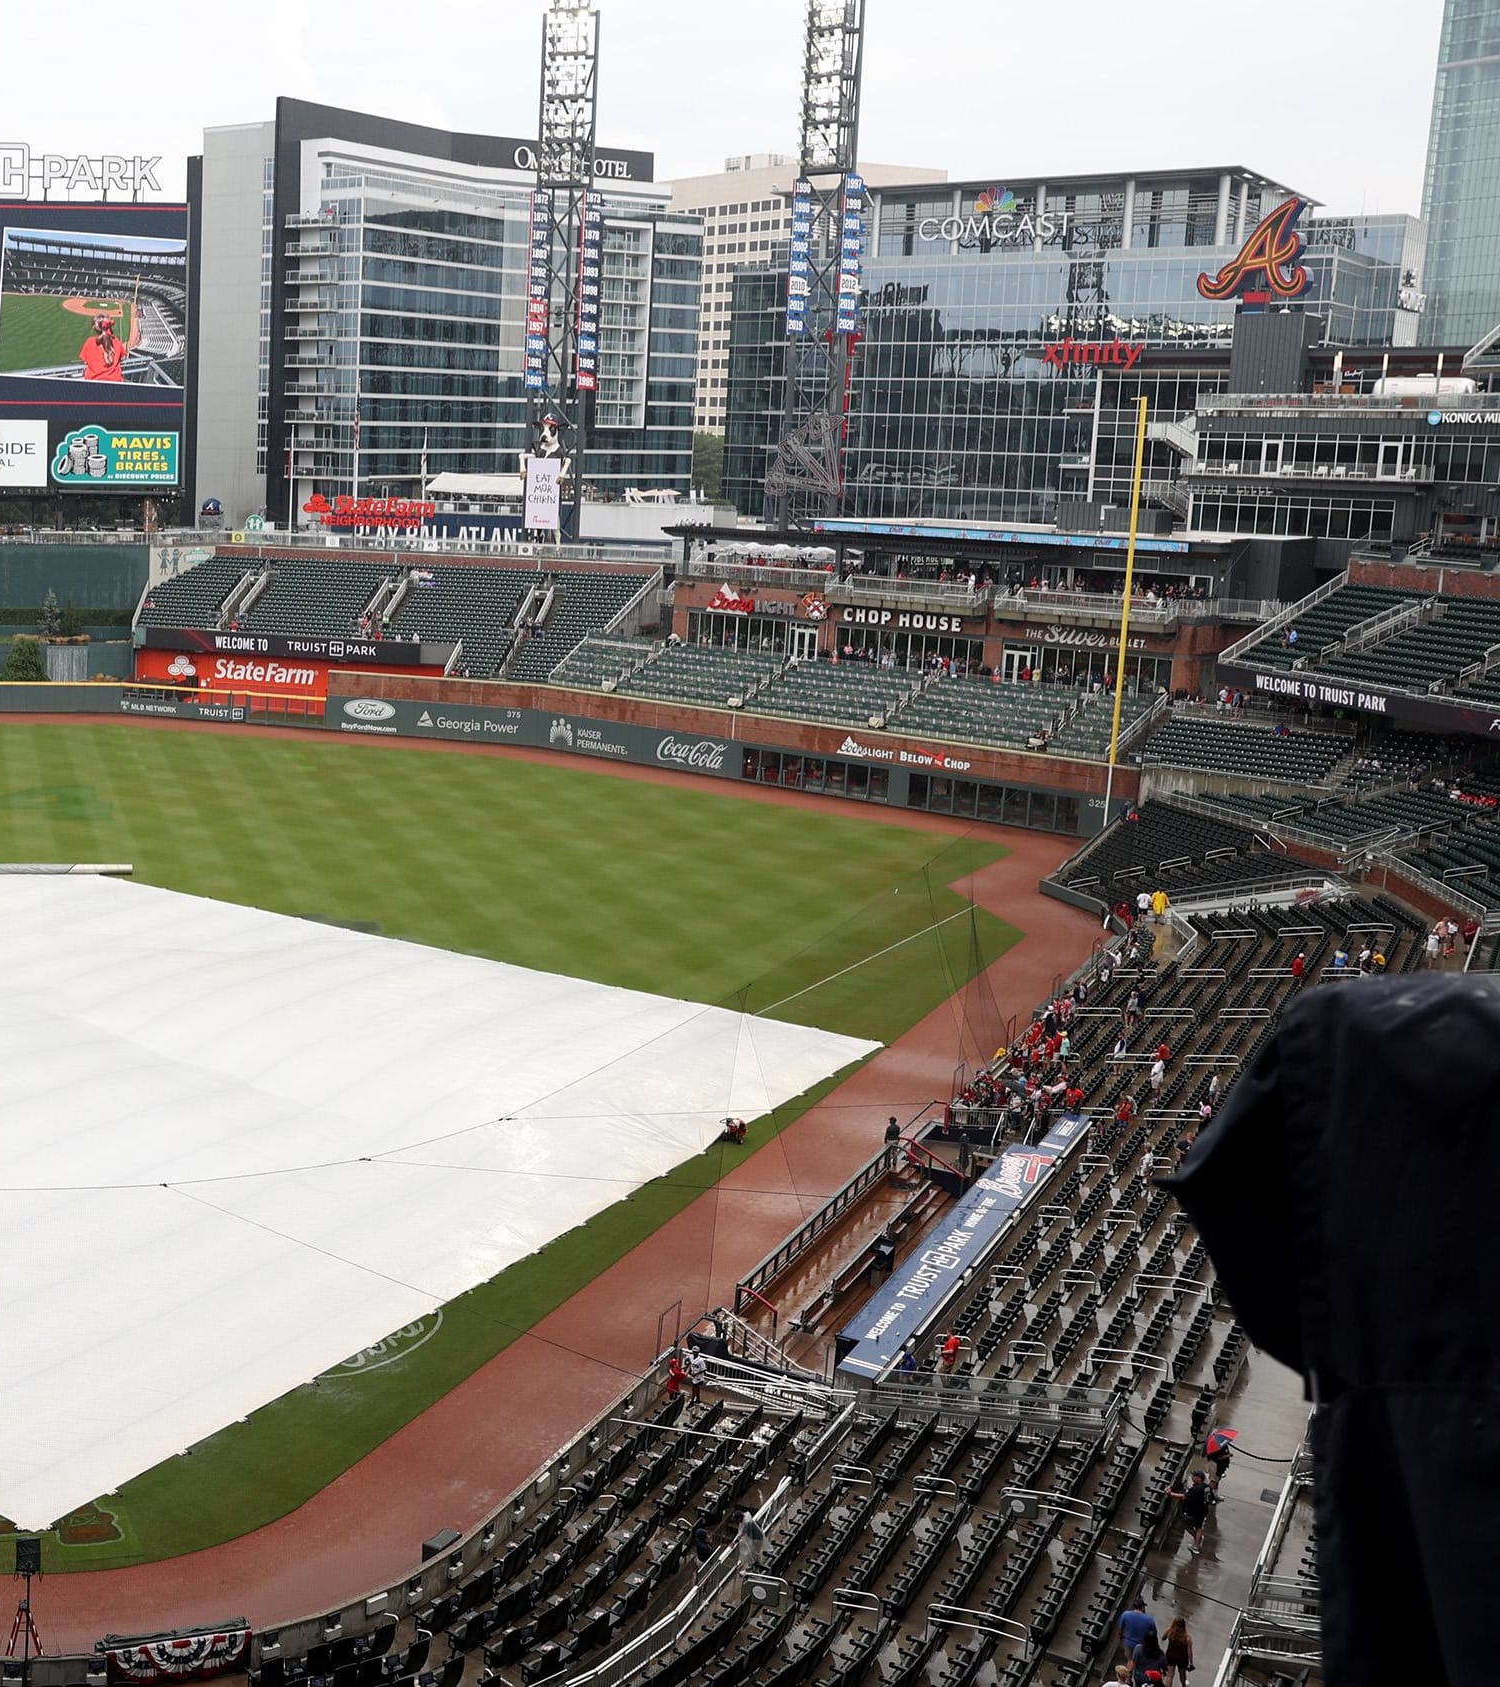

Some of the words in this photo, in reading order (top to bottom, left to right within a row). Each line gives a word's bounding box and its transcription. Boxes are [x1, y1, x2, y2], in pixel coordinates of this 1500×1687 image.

[43, 154, 162, 191] PARK
[847, 178, 862, 188] 1997
[534, 194, 548, 204] 1872
[586, 193, 601, 203] 1873
[846, 198, 861, 209] 1999
[845, 219, 860, 229] 2001
[919, 212, 1075, 241] COMCAST
[793, 241, 808, 251] 2002
[844, 239, 859, 249] 2003
[791, 261, 807, 271] 2004
[843, 259, 858, 269] 2005
[791, 280, 805, 291] 2010
[842, 279, 856, 289] 2012
[531, 285, 545, 295] 1897
[583, 285, 598, 296] 1898
[582, 303, 596, 314] 1948
[790, 300, 804, 310] 2013
[841, 299, 855, 310] 2018
[789, 321, 803, 331] 2019
[840, 319, 854, 329] 2020
[1043, 337, 1144, 371] xfinity
[527, 375, 542, 385] 1993
[579, 376, 594, 386] 1995
[1442, 412, 1481, 424] KONICA
[111, 437, 172, 449] MAVIS
[118, 451, 159, 460] TIRES
[115, 462, 168, 471] BRAKES
[536, 474, 551, 483] EAT
[534, 484, 552, 493] MOR
[528, 494, 556, 504] CHIKIN
[320, 515, 421, 528] NEIGHBORHOOD
[709, 591, 754, 612] Coors
[755, 600, 797, 616] LIGHT
[844, 607, 891, 625] CHOP
[899, 613, 962, 632] HOUSE
[1025, 629, 1043, 639] THE
[1044, 624, 1107, 647] Silver
[215, 636, 255, 650] WELCOME
[257, 639, 268, 651] TO
[287, 641, 327, 653] TRUIST
[347, 645, 376, 656] PARK
[1256, 674, 1301, 696] WELCOME
[1303, 683, 1316, 699] TO
[1319, 686, 1355, 707] TRUIST
[1358, 693, 1386, 712] PARK
[146, 705, 177, 713] NETWORK
[199, 708, 228, 717] TRUIST
[353, 702, 385, 717] Ford
[507, 710, 521, 718] 375
[341, 722, 397, 733] BuyFordNow.com
[436, 716, 480, 732] Georgia
[483, 722, 519, 734] Power
[577, 728, 601, 739] KAISER
[577, 740, 625, 755] PERMANENTE
[657, 736, 728, 769] Coca-Cola
[868, 749, 893, 759] LIGHT
[1088, 799, 1106, 809] 325
[864, 1309, 900, 1340] WELCOME
[896, 1264, 942, 1299] TRUIST
[938, 1229, 974, 1255] PARK
